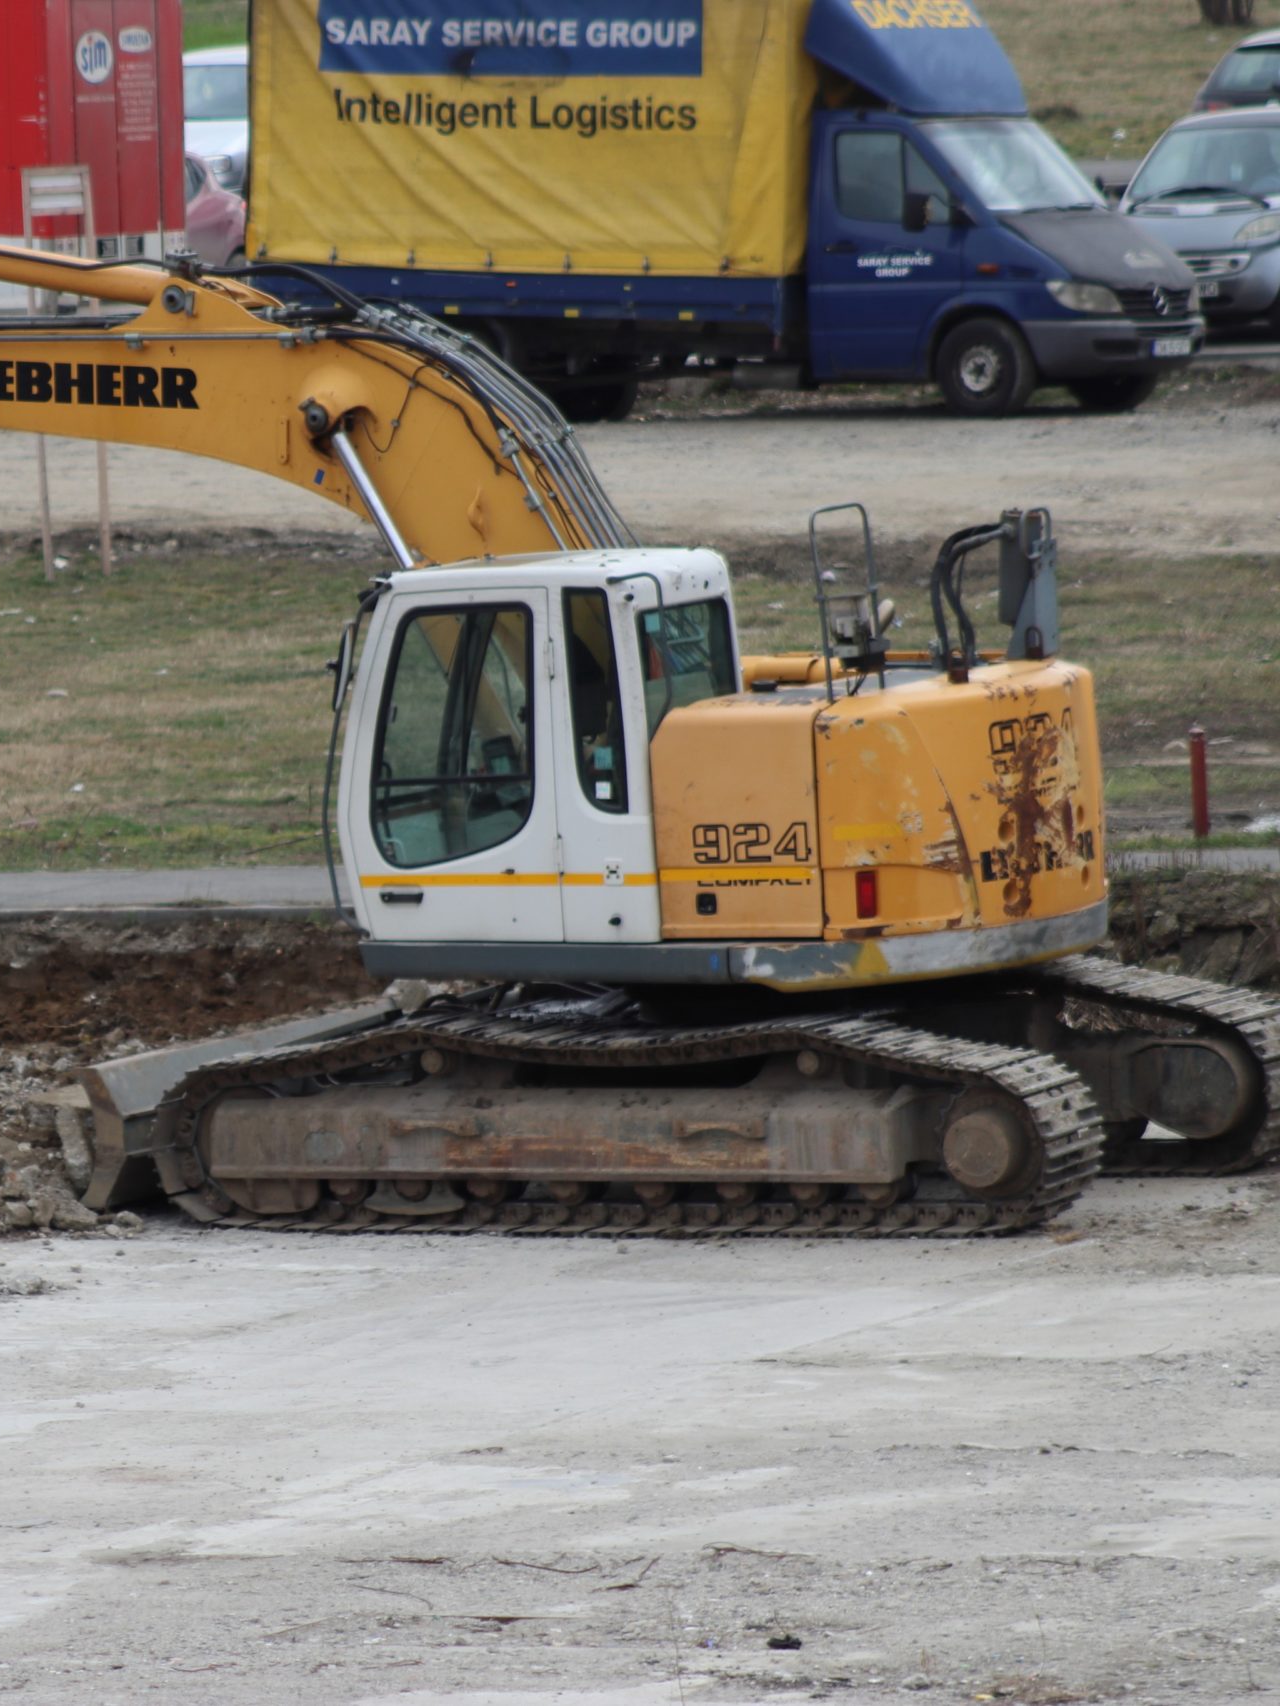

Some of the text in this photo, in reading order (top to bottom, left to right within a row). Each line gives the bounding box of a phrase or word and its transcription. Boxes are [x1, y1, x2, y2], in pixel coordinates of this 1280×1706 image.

[325, 18, 697, 48] SARAY SERVICE GROUP
[81, 36, 108, 75] sim
[334, 88, 697, 138] Intelligent Logistics
[857, 255, 933, 268] SARAY SERVICE
[875, 267, 909, 278] GROUP
[692, 822, 812, 864] 924
